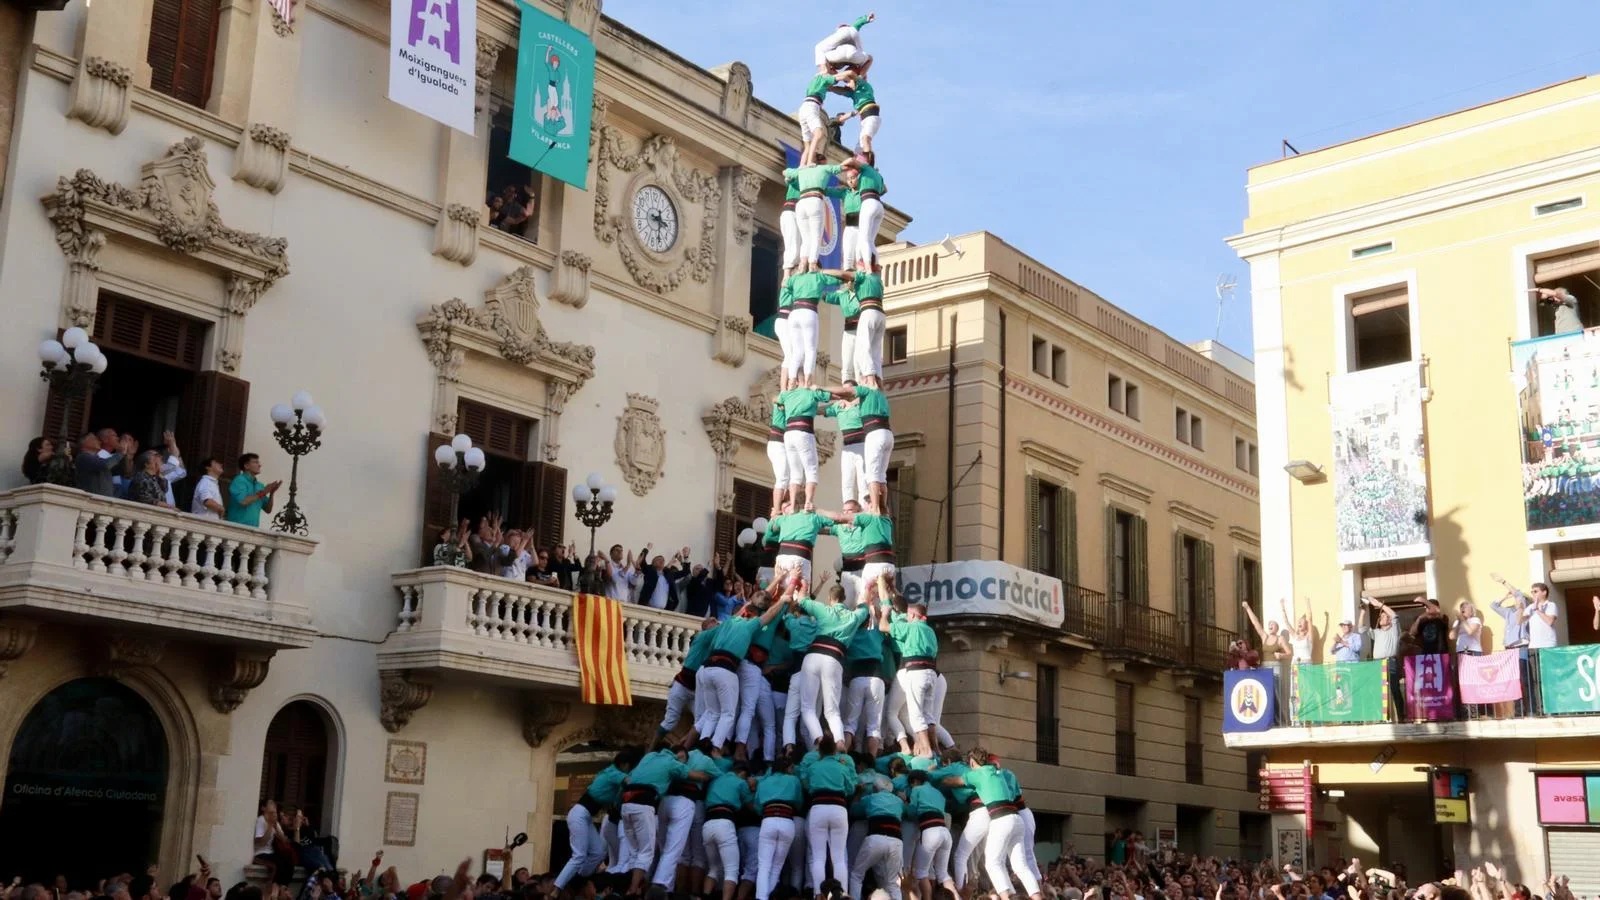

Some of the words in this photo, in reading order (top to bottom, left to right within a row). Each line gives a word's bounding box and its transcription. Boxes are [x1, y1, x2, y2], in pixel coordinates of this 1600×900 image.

[538, 31, 578, 56] CASTELLERS
[399, 48, 467, 86] Moixiganguers
[408, 67, 459, 96] d'Igualada
[13, 783, 52, 796] Oficina
[105, 788, 157, 801] Ciutadana
